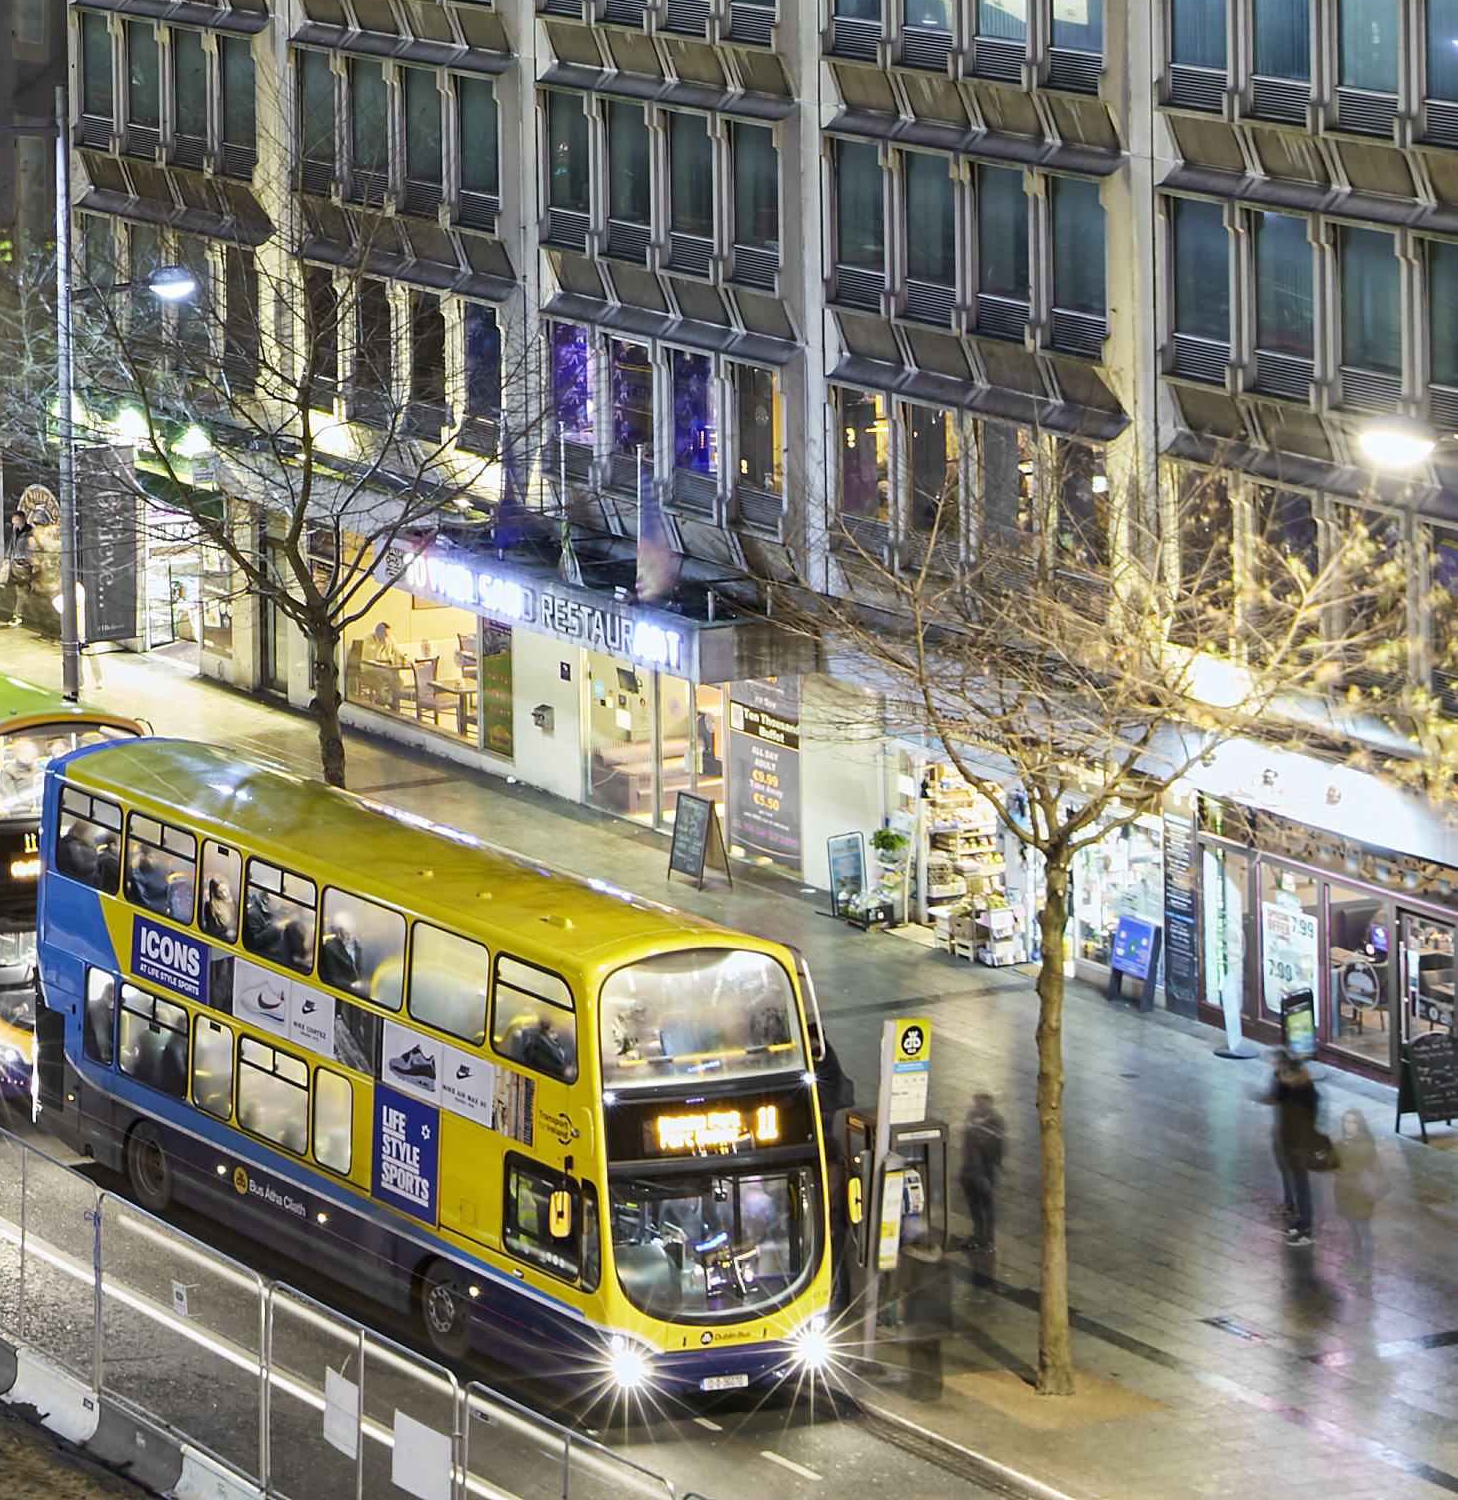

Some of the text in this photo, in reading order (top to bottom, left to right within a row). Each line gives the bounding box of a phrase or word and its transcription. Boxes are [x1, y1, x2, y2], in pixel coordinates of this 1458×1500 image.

[541, 594, 682, 668] RESTAURANT
[744, 707, 759, 722] Ten
[759, 725, 785, 743] Buffet
[140, 926, 201, 978] ICONS
[140, 963, 200, 996] AT LIFE STYLE SPORTS
[293, 1021, 306, 1031] NIKE
[307, 1025, 327, 1040] CORTEZ
[442, 1084, 455, 1094] NIKE
[457, 1089, 466, 1099] AIR
[467, 1094, 478, 1104] MAX
[382, 1104, 406, 1137] LIFE
[539, 1109, 568, 1129] Transport
[382, 1133, 420, 1170] STYLE
[381, 1161, 429, 1201] SPORTS
[249, 1179, 307, 1217] Bus Átha Cliath
